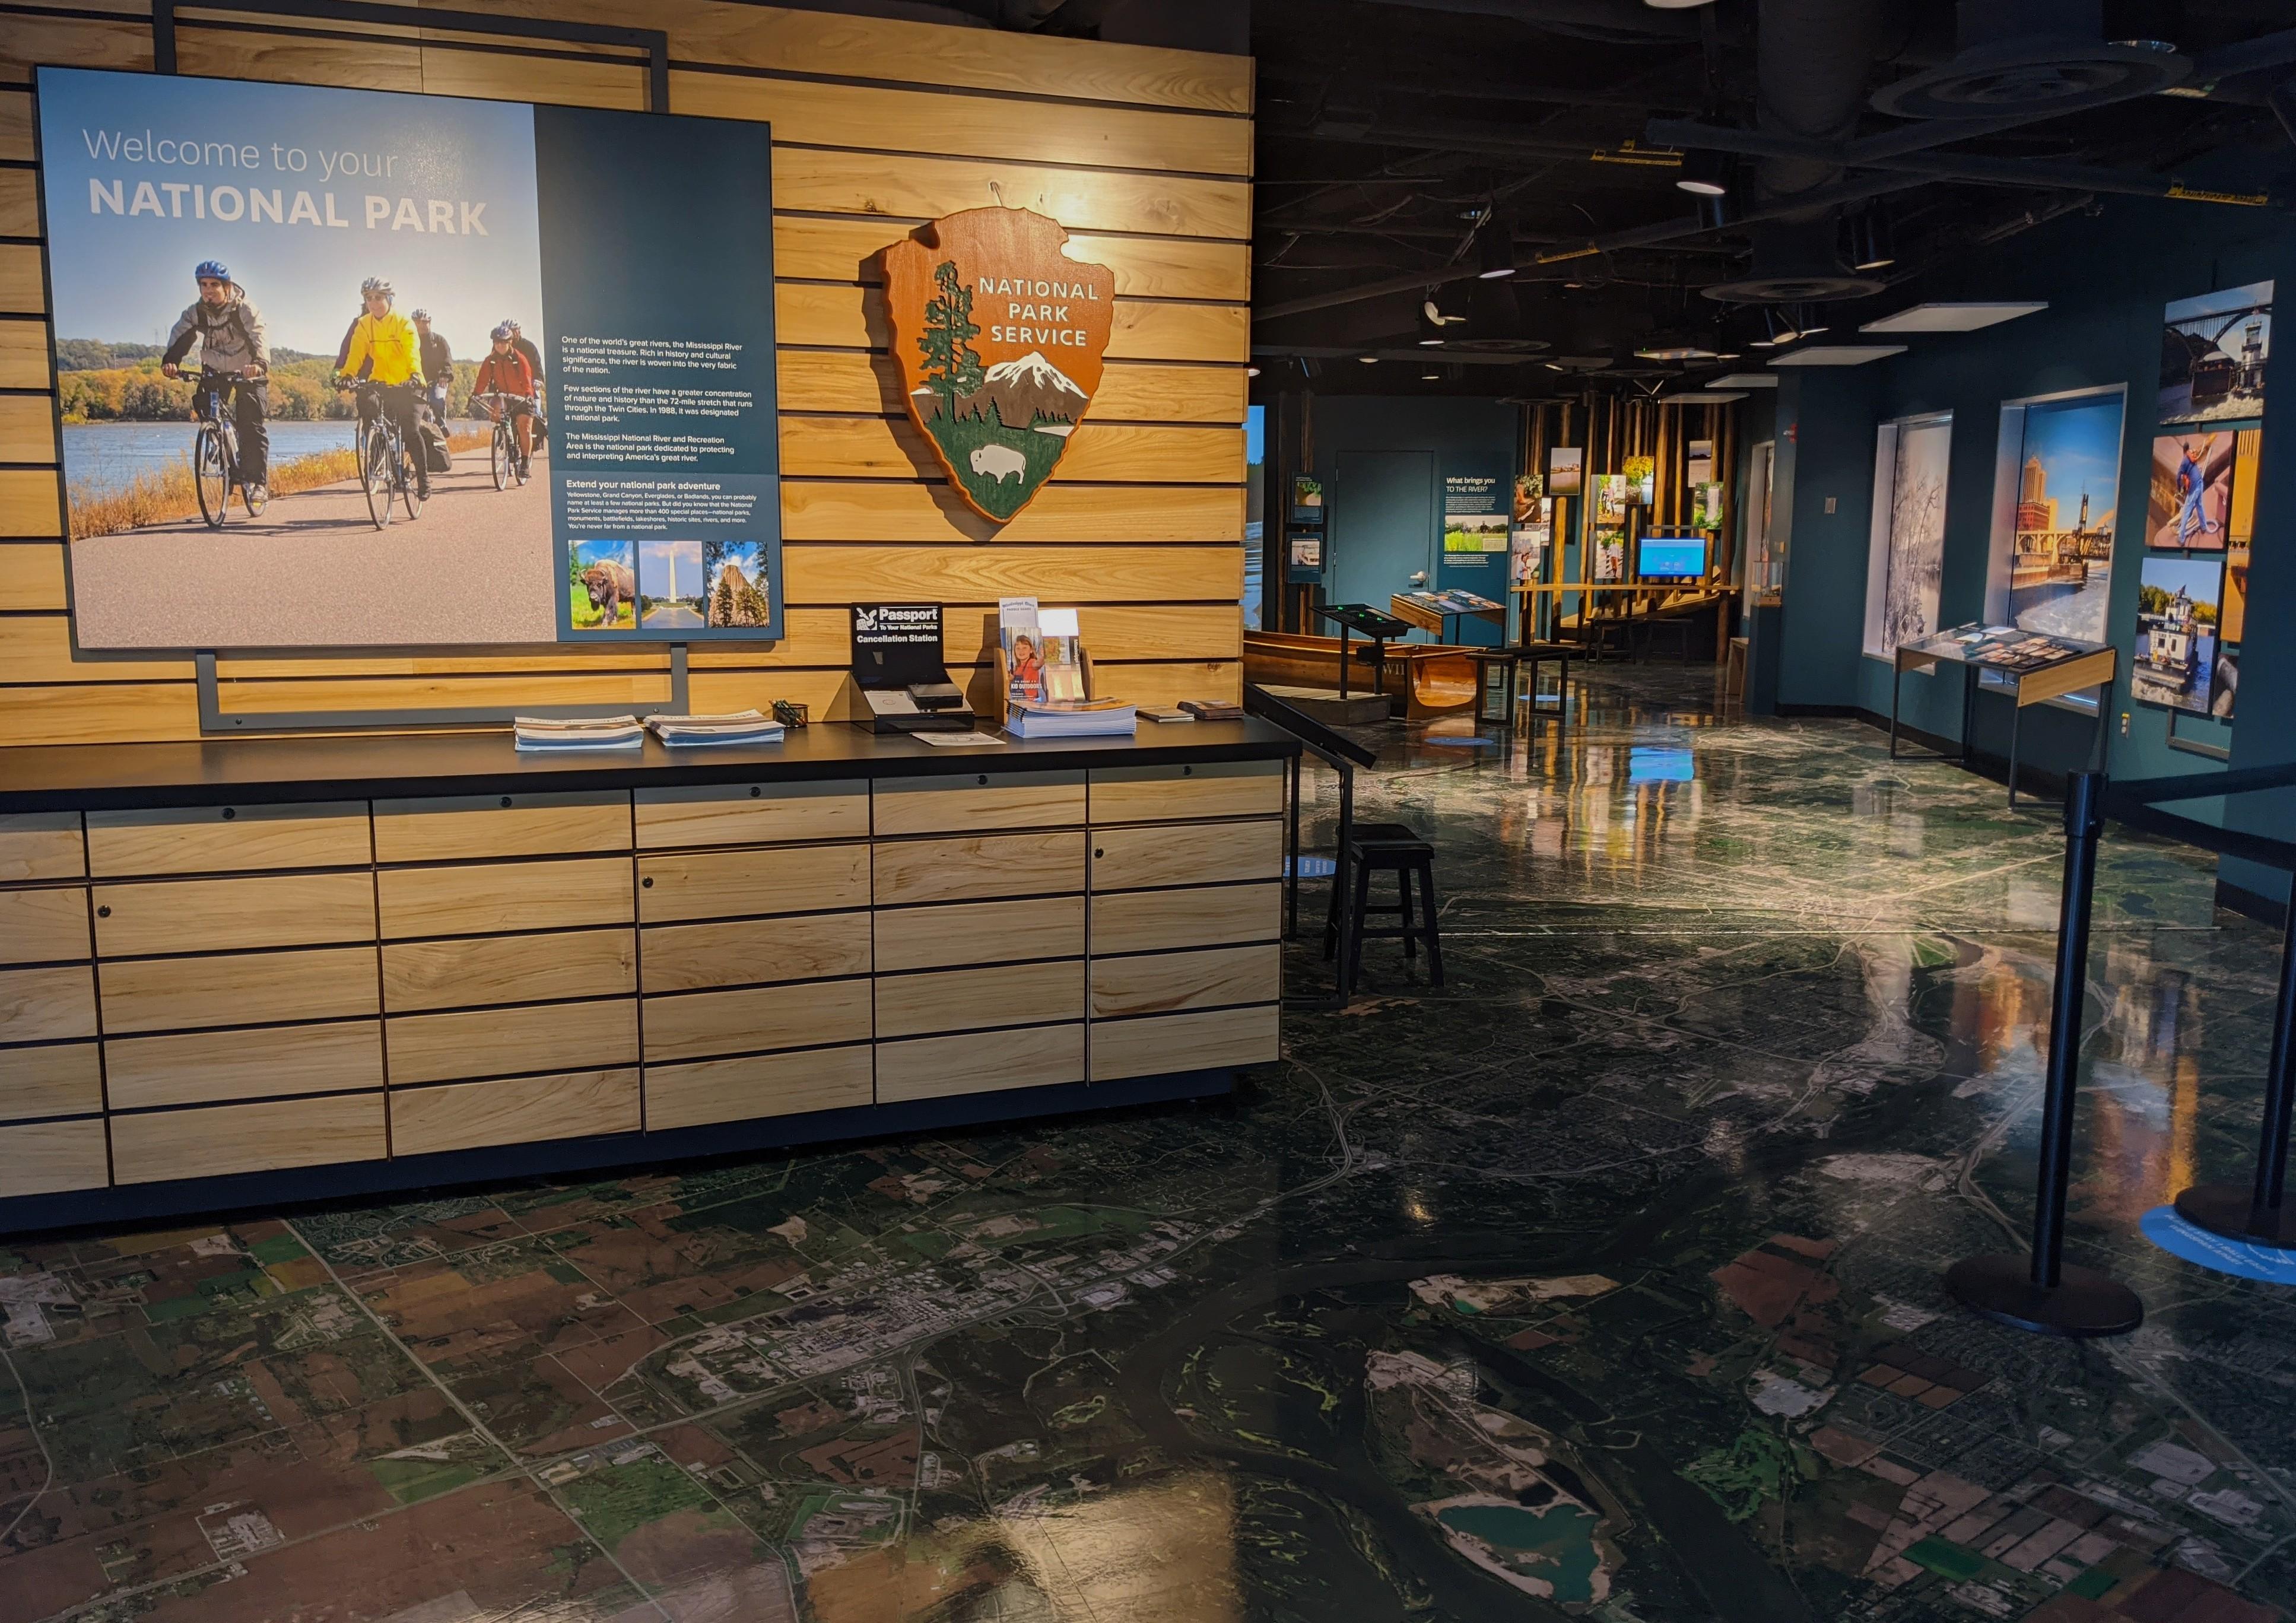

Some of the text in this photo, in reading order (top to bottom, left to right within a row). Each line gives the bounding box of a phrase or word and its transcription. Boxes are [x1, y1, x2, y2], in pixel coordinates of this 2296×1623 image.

[79, 130, 401, 186] Welcome to your
[90, 180, 489, 235] NATIONAL PARK
[980, 277, 1098, 299] NATIONAL
[1009, 303, 1068, 321] PARK
[991, 326, 1086, 345] SERVICE
[685, 341, 723, 351] Mississippi
[665, 350, 689, 359] history
[563, 356, 607, 364] significance,
[614, 396, 638, 405] history
[564, 404, 593, 412] through
[700, 408, 739, 417] designated
[582, 433, 620, 442] Mississippi
[699, 446, 734, 455] protecting
[582, 453, 623, 461] interpreting
[566, 479, 596, 488] Extend
[620, 481, 655, 489] national
[657, 481, 676, 491] park
[1464, 477, 1483, 485] brings
[879, 608, 938, 622] Passport
[857, 634, 907, 643] Cancellation
